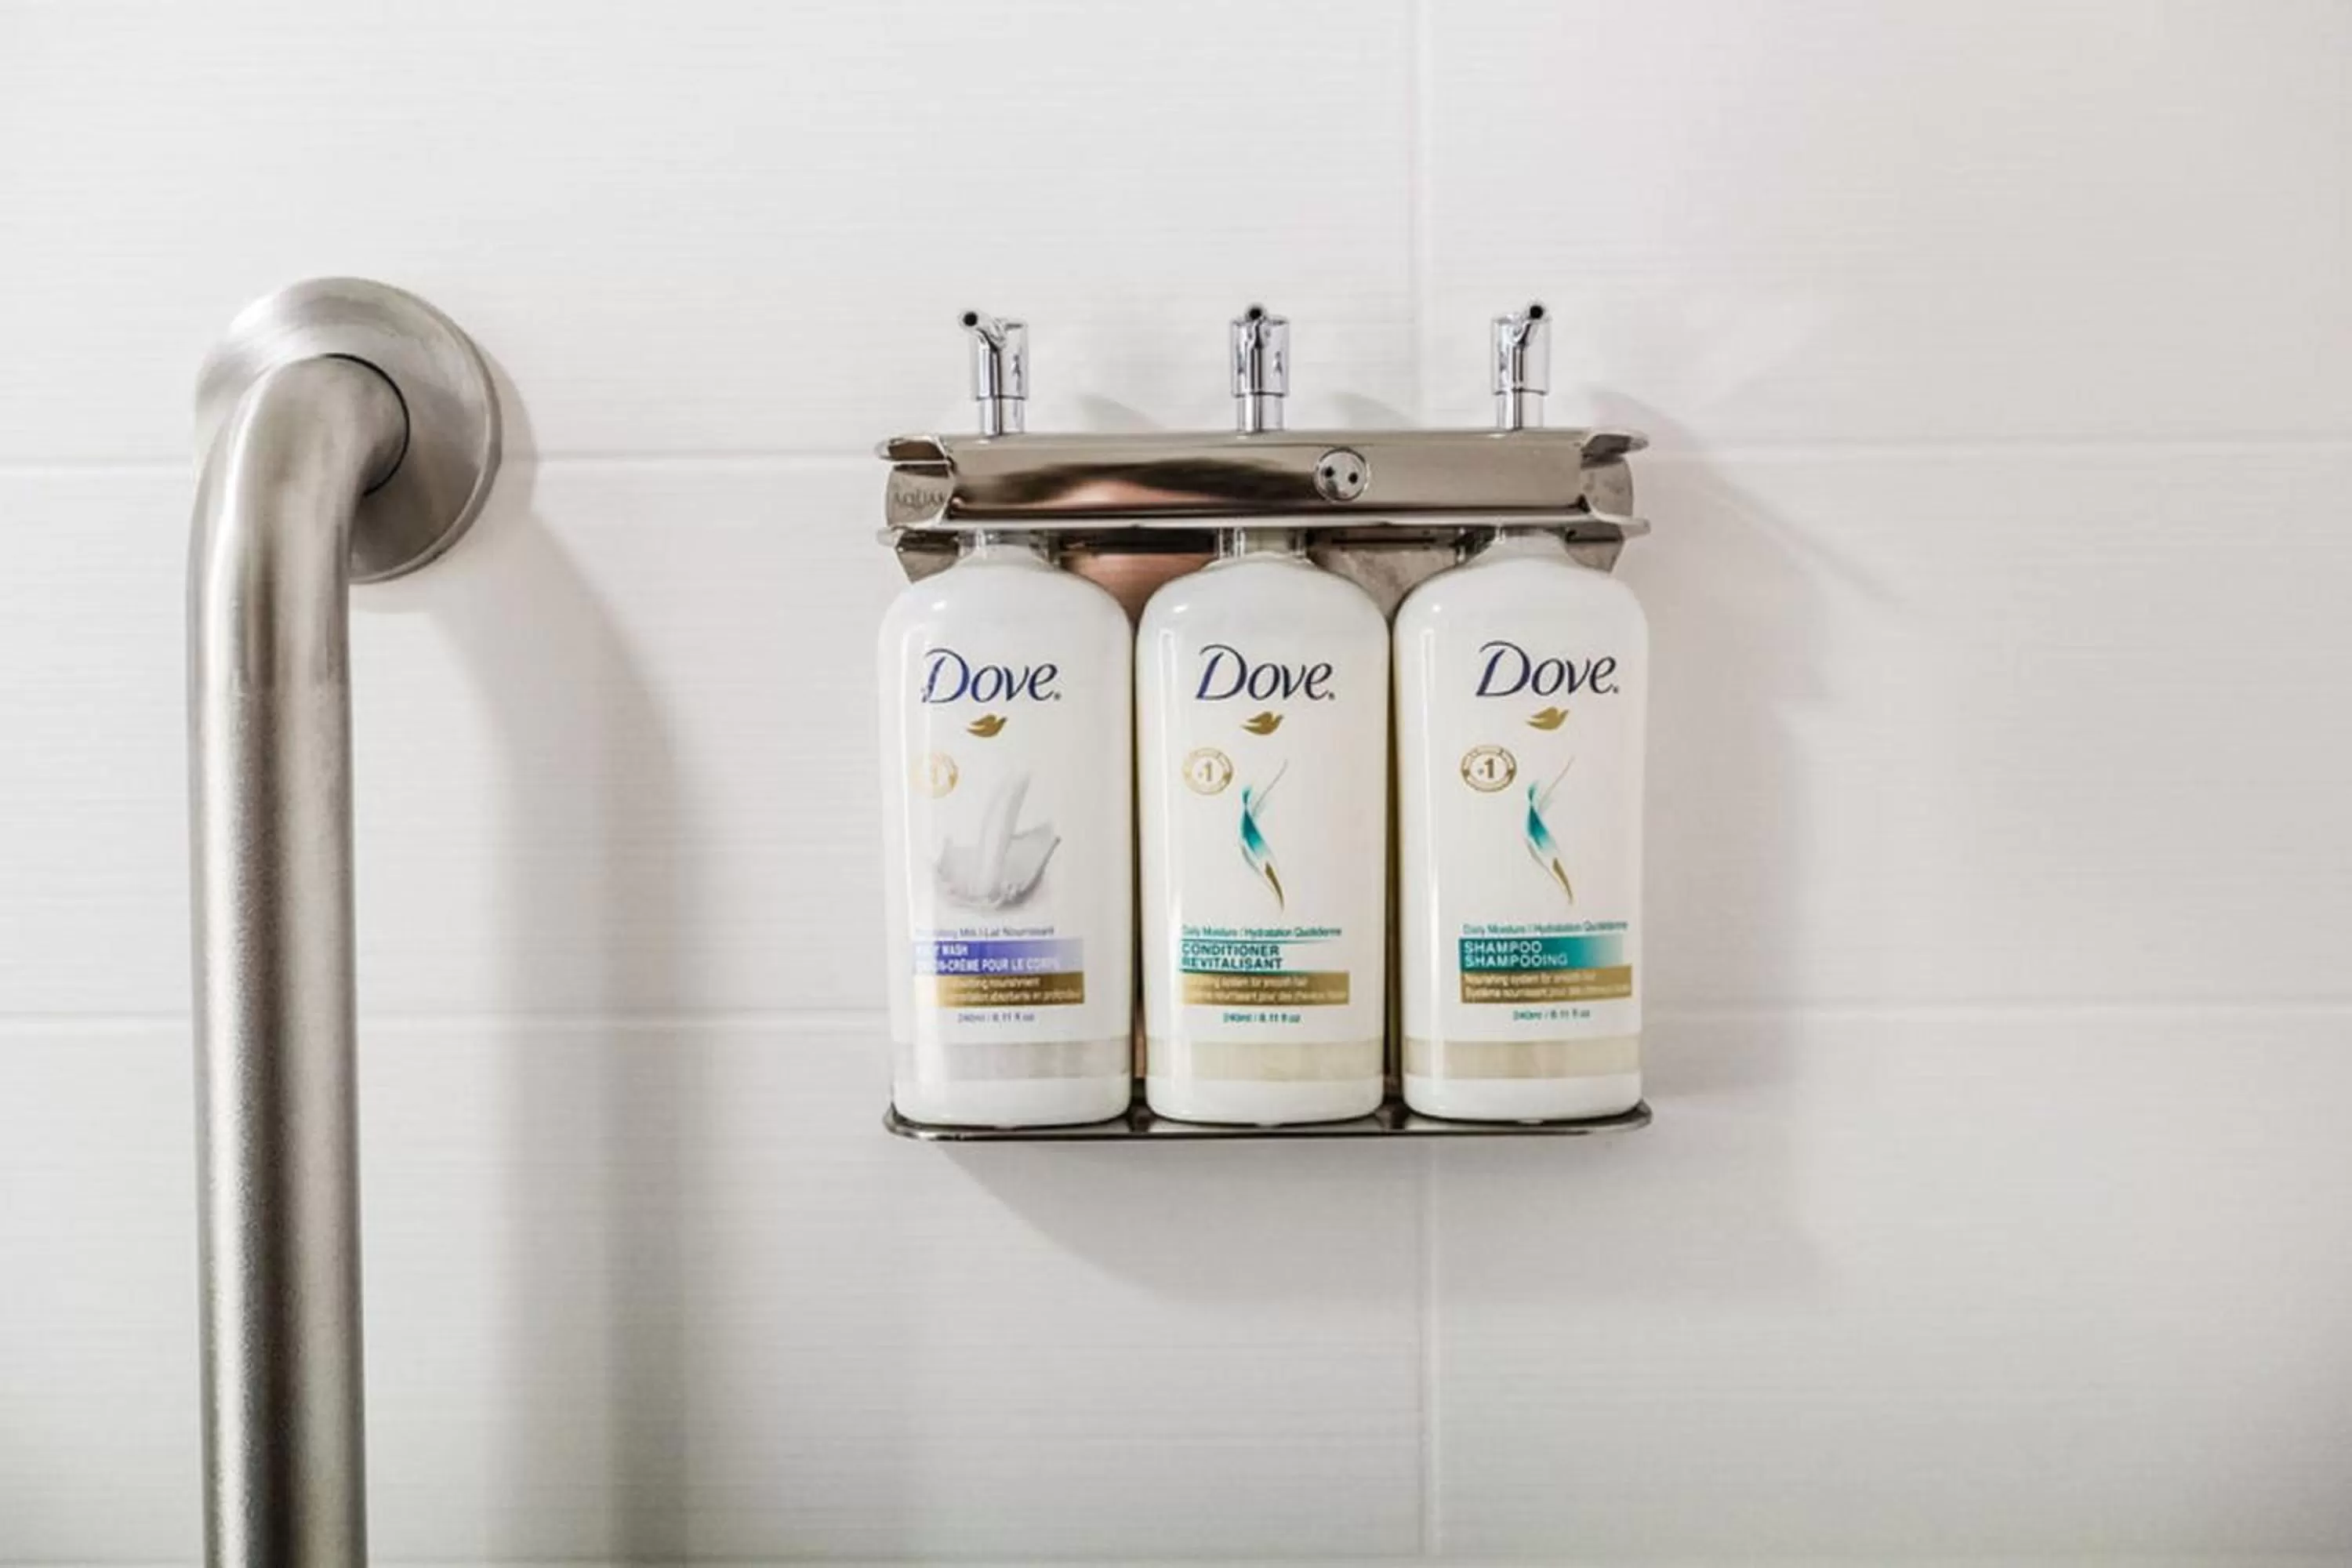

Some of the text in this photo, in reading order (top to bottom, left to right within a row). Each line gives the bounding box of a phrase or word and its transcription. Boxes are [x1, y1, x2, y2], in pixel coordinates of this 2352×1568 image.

[922, 648, 1058, 703] Dove
[1196, 644, 1333, 701] Dove
[1475, 640, 1617, 697] Dove
[1181, 944, 1280, 956] CONDITIONER
[1464, 941, 1543, 954] SHAMPOO
[982, 957, 1009, 972] POUR
[1181, 956, 1283, 970] REVITALISANT
[1464, 953, 1569, 967] SHAMPOOING
